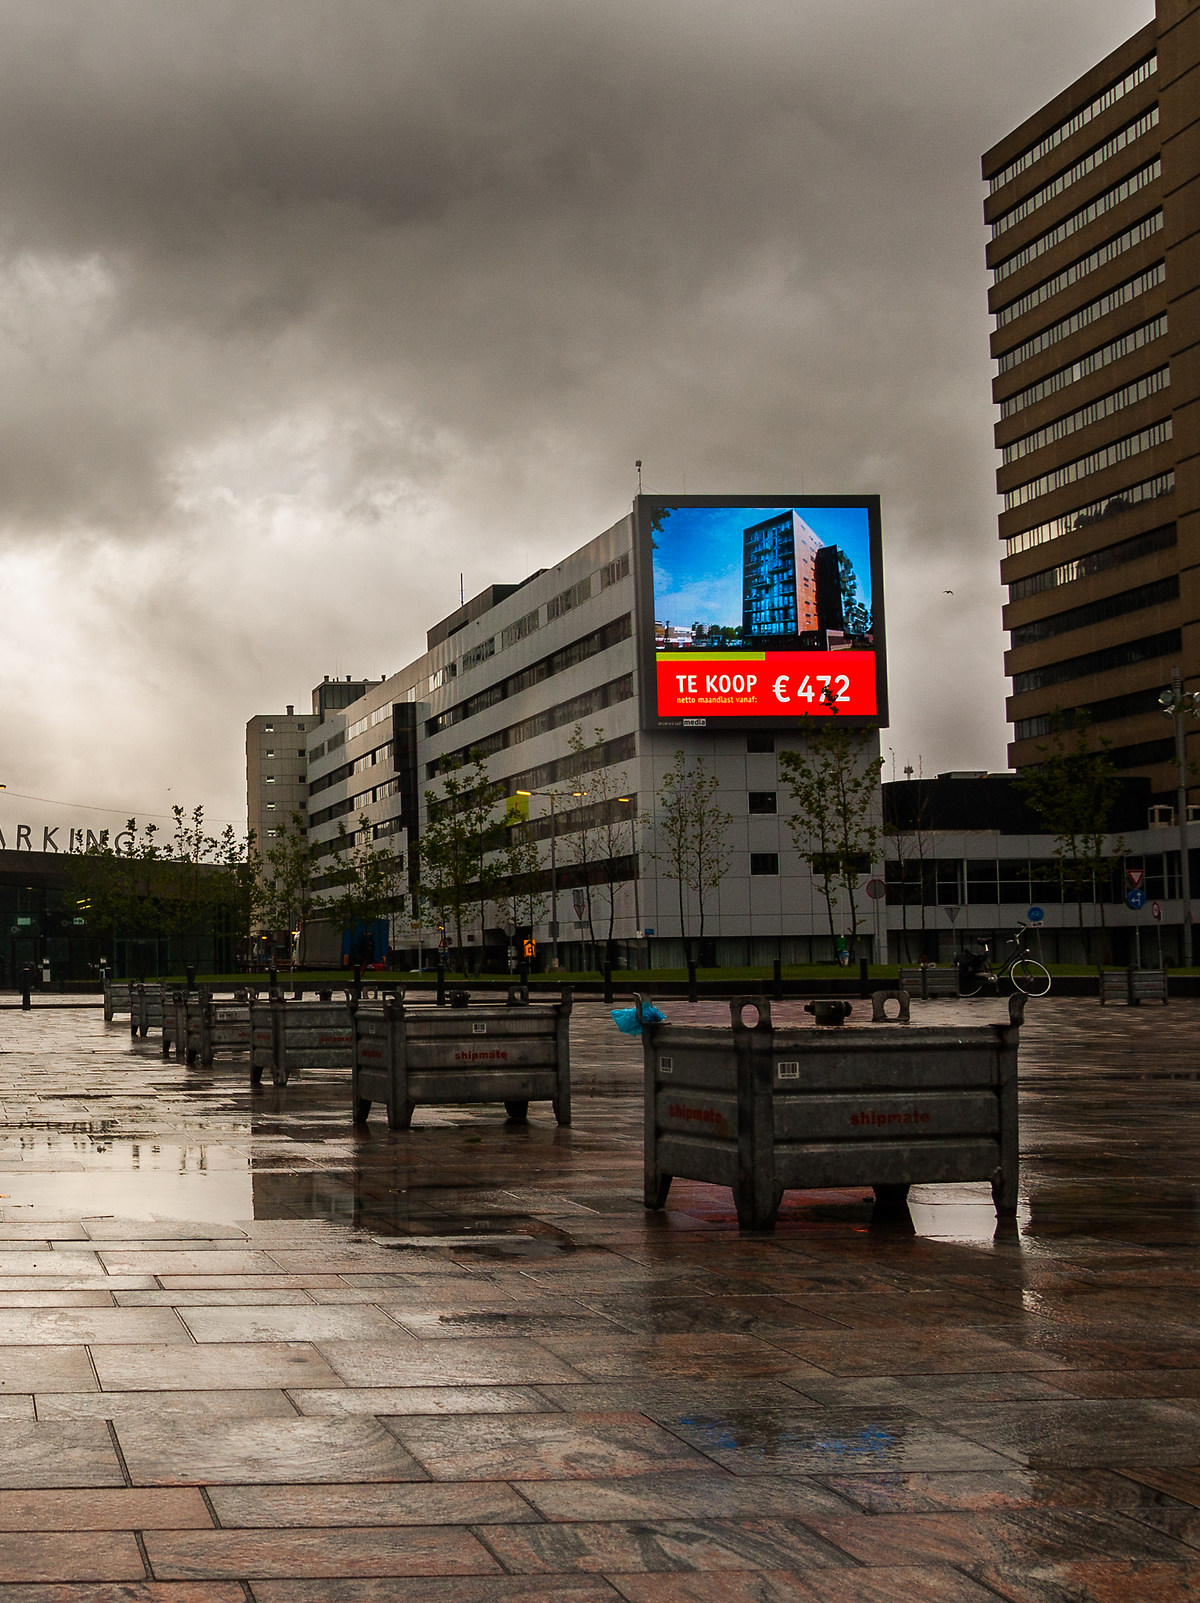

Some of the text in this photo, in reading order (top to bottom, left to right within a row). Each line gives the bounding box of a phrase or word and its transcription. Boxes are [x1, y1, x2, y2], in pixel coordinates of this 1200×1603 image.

[675, 674, 758, 693] TE KOOP
[772, 674, 851, 703] € 472
[697, 696, 734, 704] maandlast
[735, 696, 758, 704] vanaf:
[454, 1050, 508, 1063] shipmate
[669, 1103, 722, 1124] shipmate
[851, 1110, 930, 1128] shipmate
